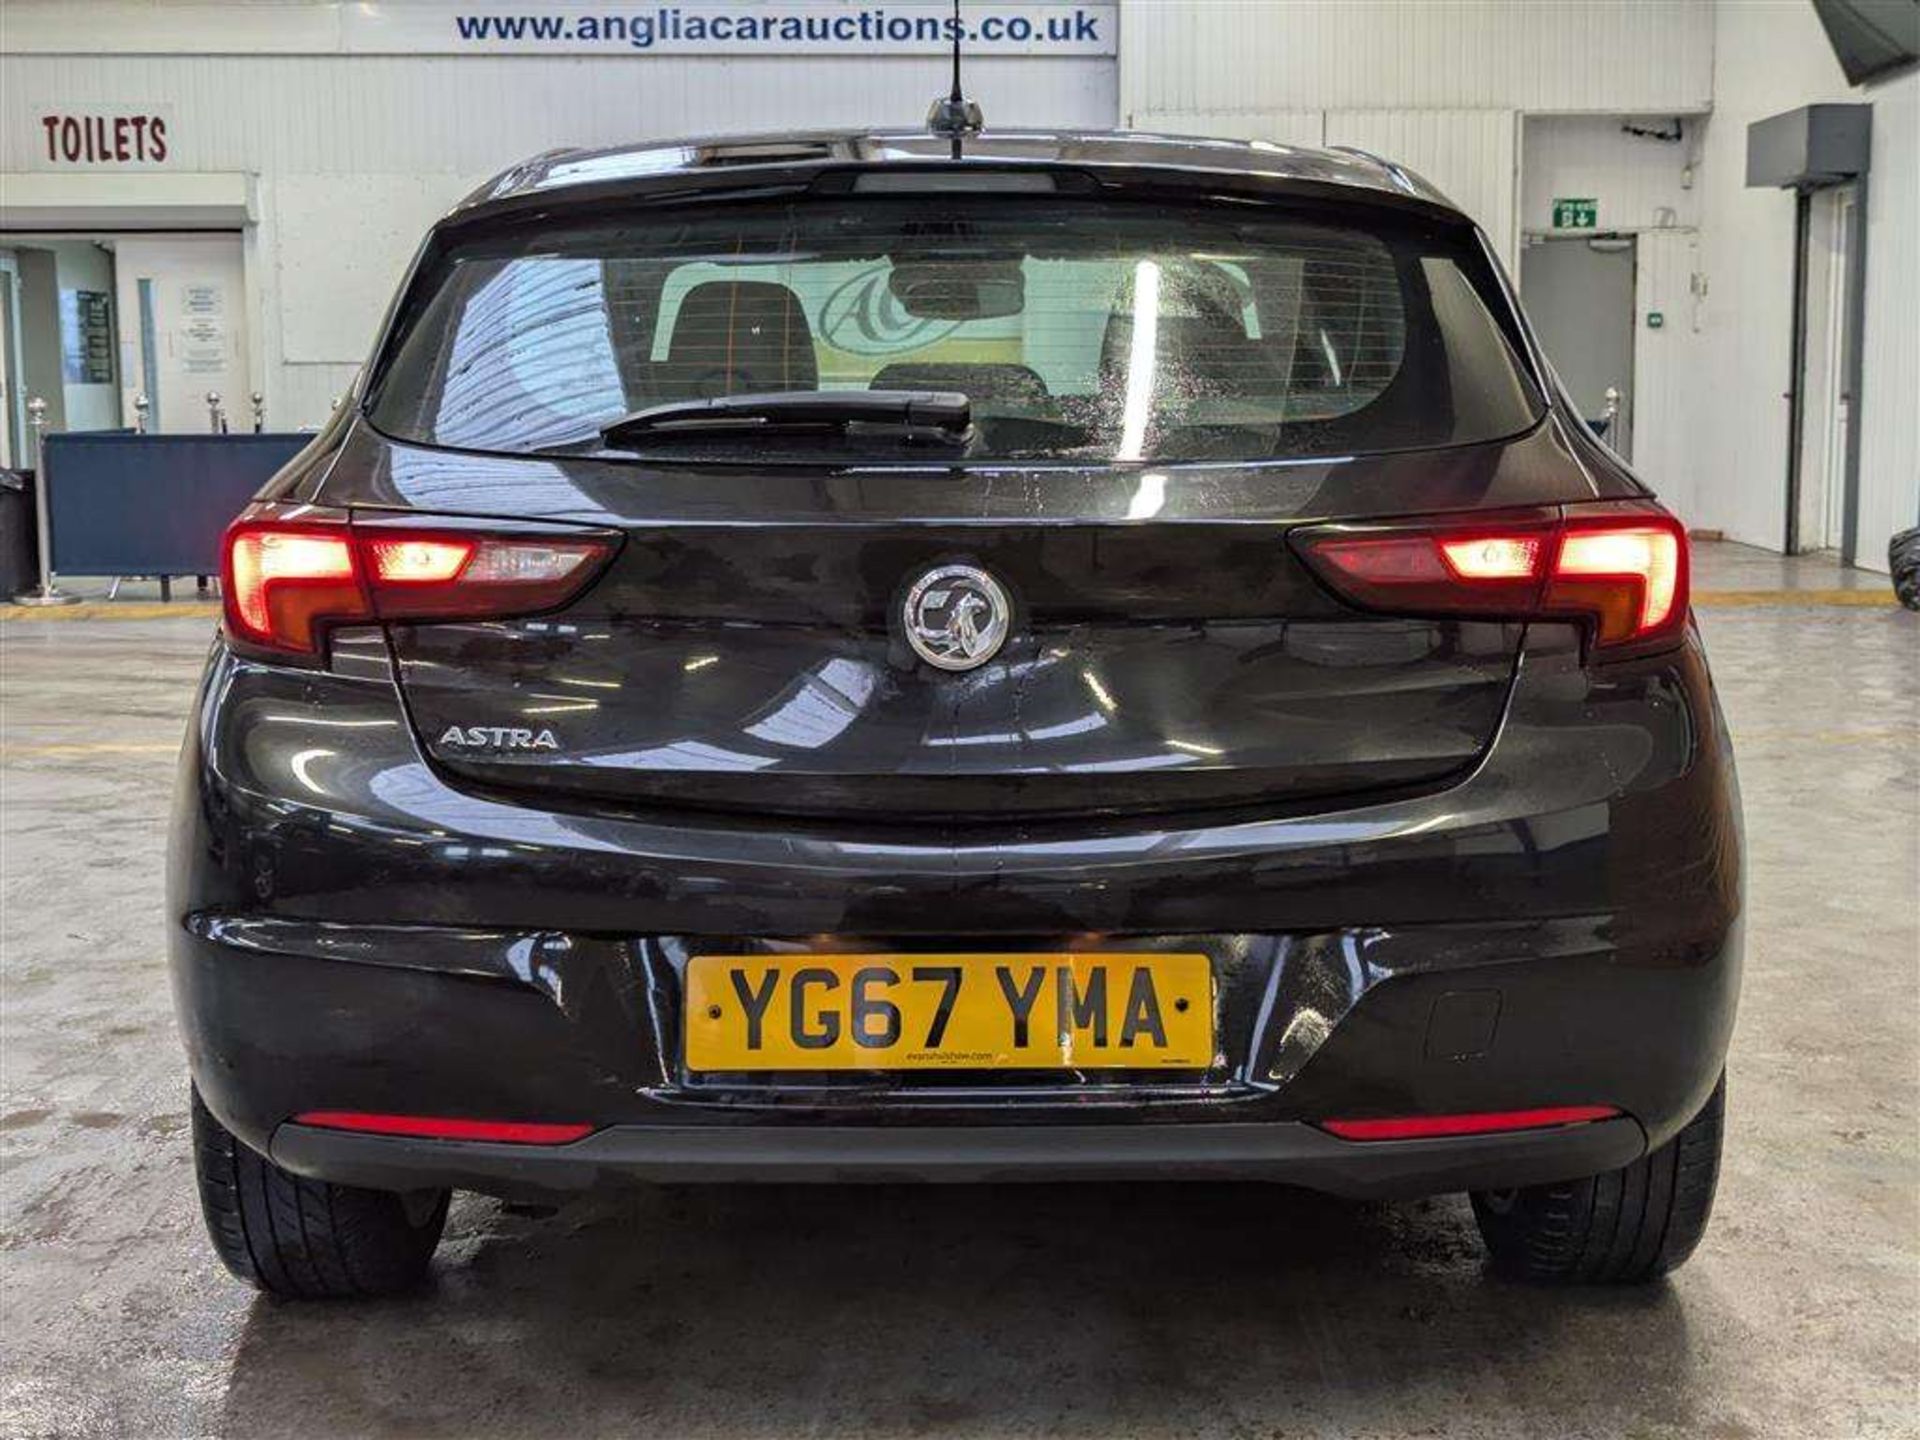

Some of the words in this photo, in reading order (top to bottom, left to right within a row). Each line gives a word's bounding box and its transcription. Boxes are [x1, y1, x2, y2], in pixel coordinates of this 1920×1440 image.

[456, 9, 1099, 47] www.angliacarauctions.co.uk
[42, 115, 167, 163] TOILETS
[440, 725, 559, 749] ASTRA
[730, 966, 962, 1050] YG67
[995, 966, 1168, 1048] YMA
